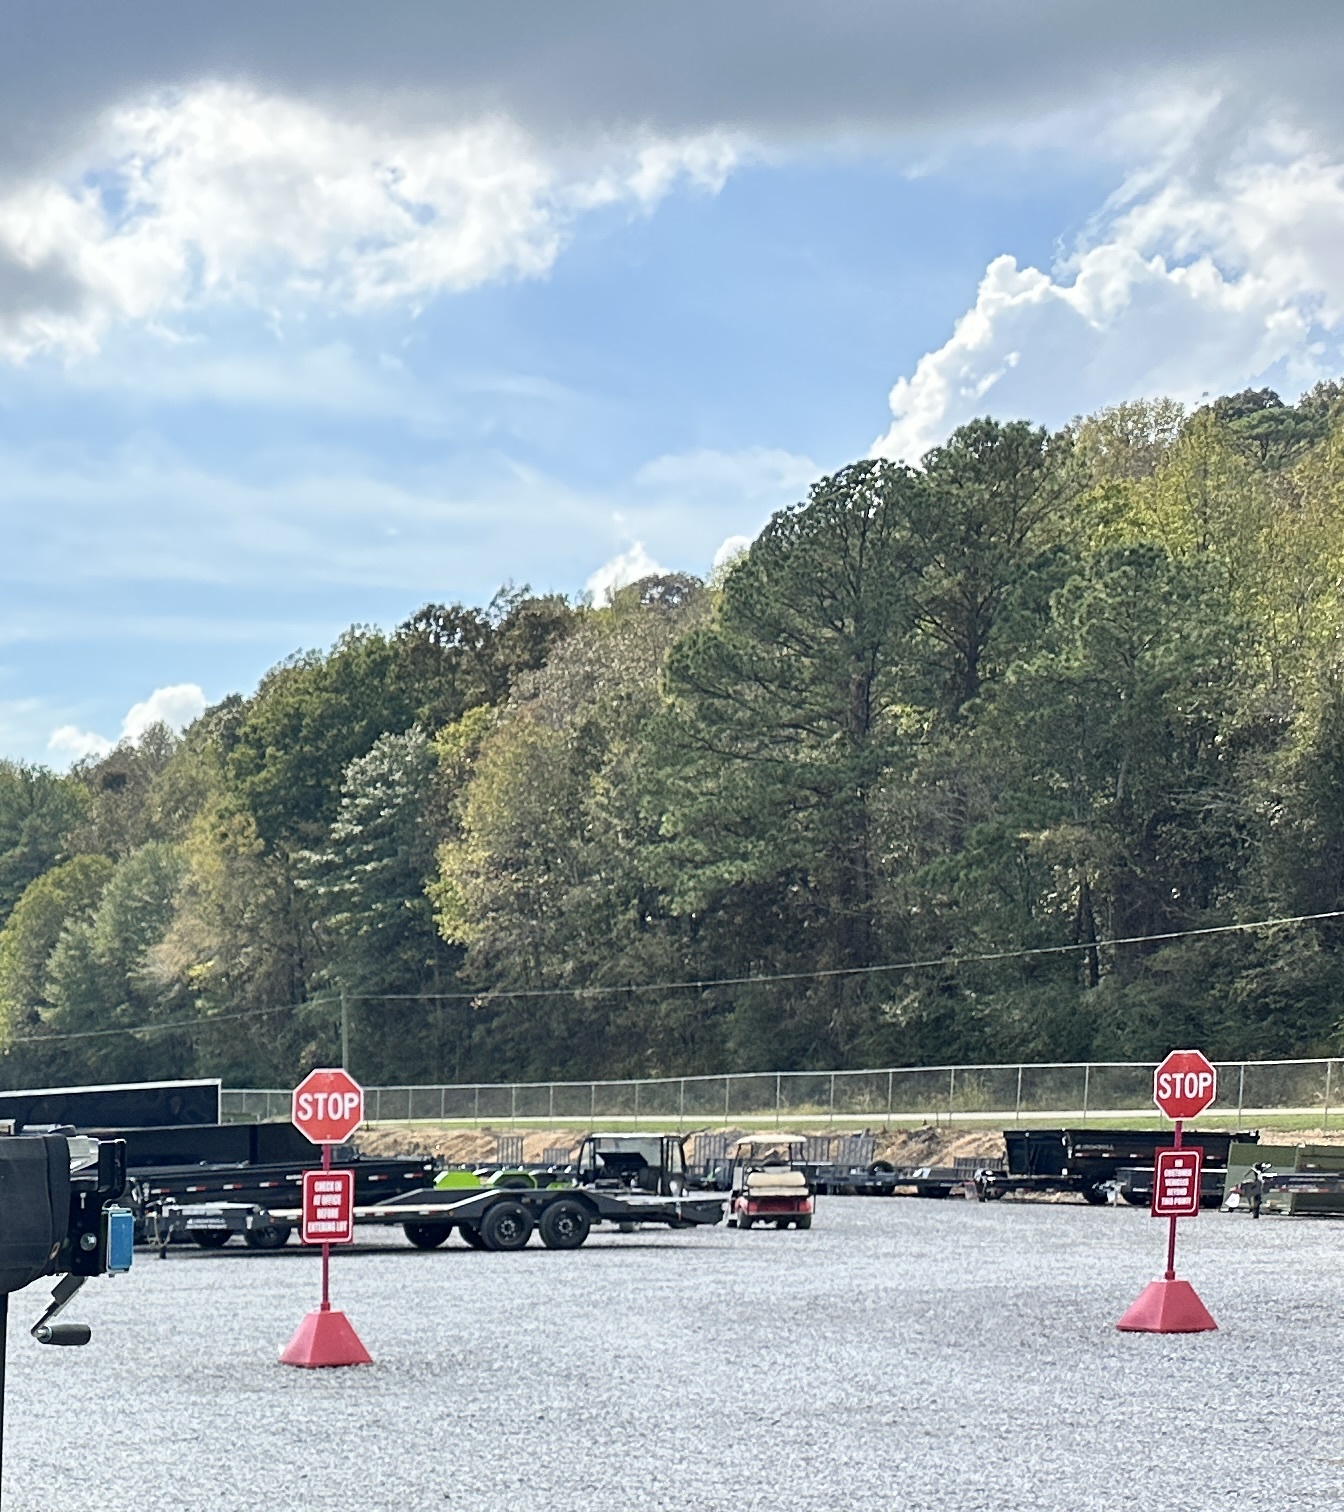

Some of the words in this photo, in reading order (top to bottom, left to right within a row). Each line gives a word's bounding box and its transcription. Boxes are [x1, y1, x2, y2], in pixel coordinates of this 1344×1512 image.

[1157, 1073, 1213, 1100] STOP
[297, 1092, 359, 1121] STOP
[314, 1180, 335, 1192] CHECK
[334, 1180, 342, 1192] IN
[313, 1194, 321, 1206] AT
[307, 1221, 336, 1233] ENTERING
[336, 1220, 348, 1232] LOT
